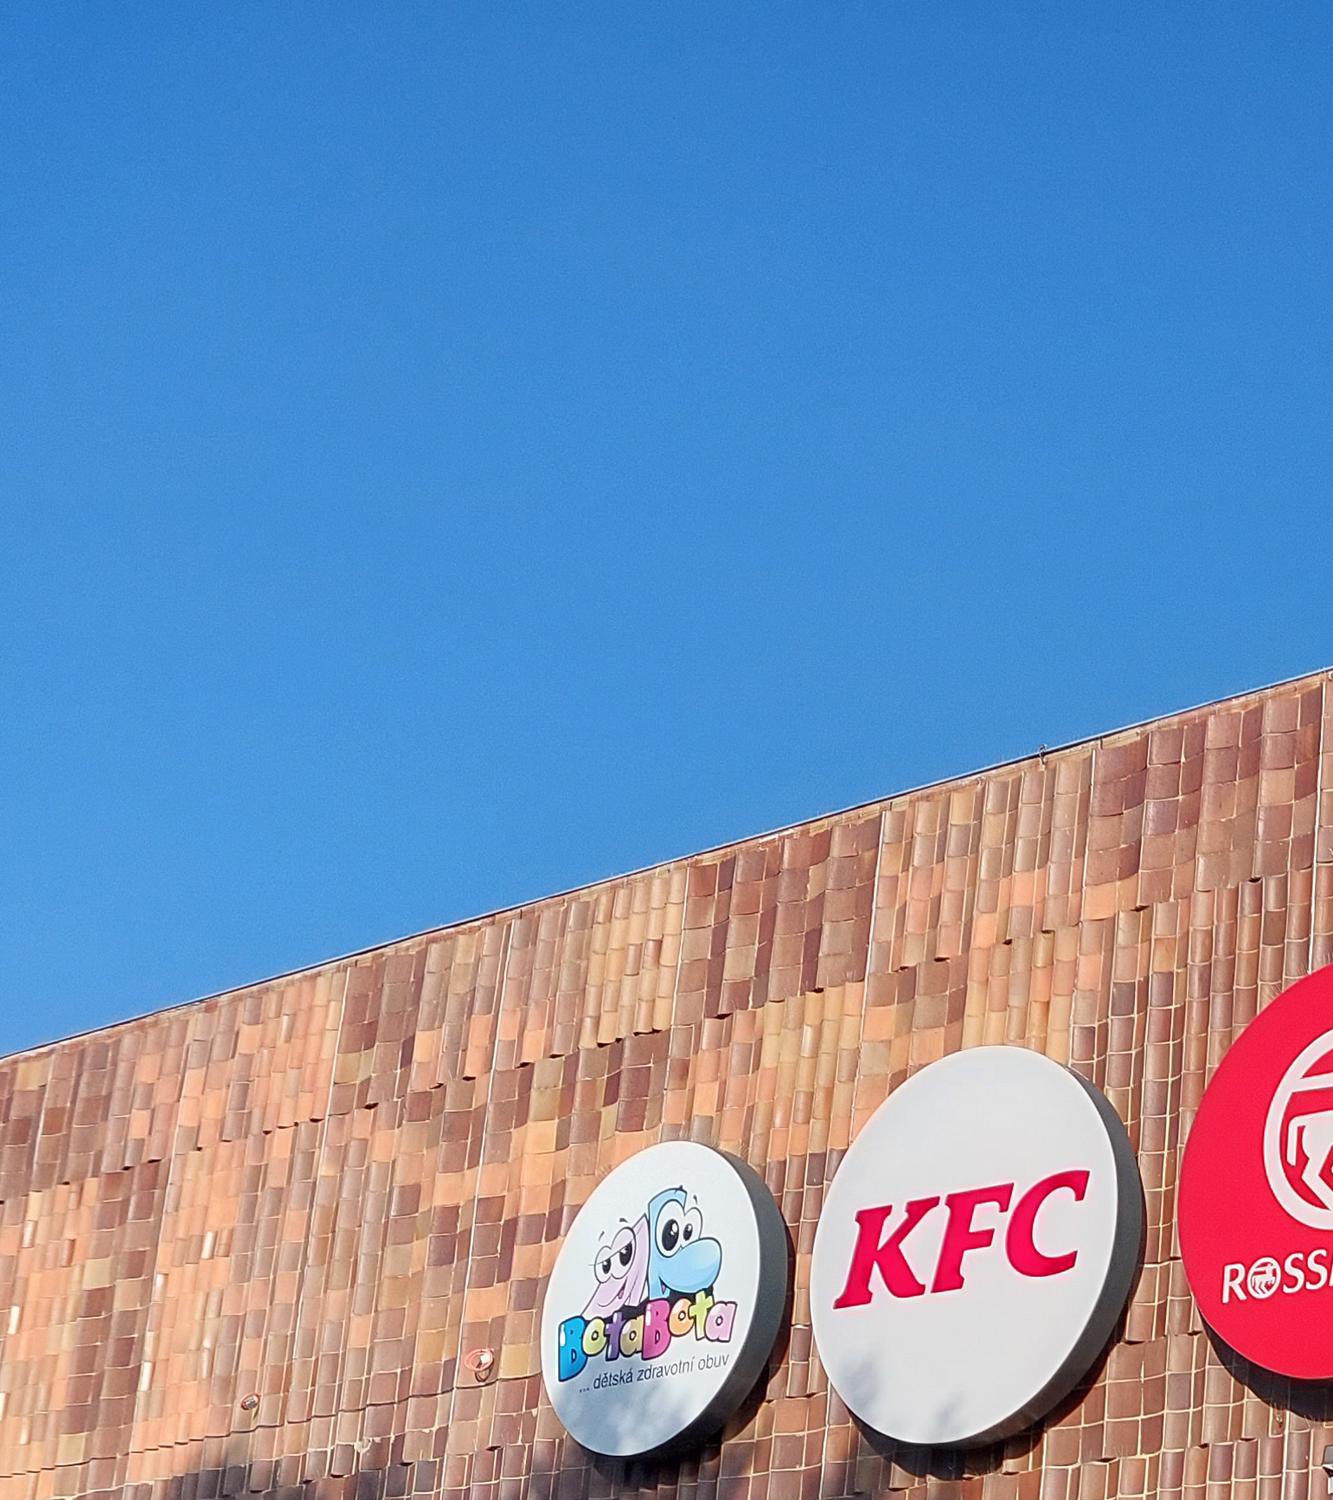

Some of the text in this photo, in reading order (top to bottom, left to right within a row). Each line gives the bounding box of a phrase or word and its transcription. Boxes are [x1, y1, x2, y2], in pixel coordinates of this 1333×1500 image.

[833, 1169, 1090, 1310] KFC
[558, 1291, 738, 1382] BotaBota
[593, 1368, 633, 1390] dětská
[637, 1356, 695, 1382] zdravotní
[697, 1354, 730, 1371] obuv
